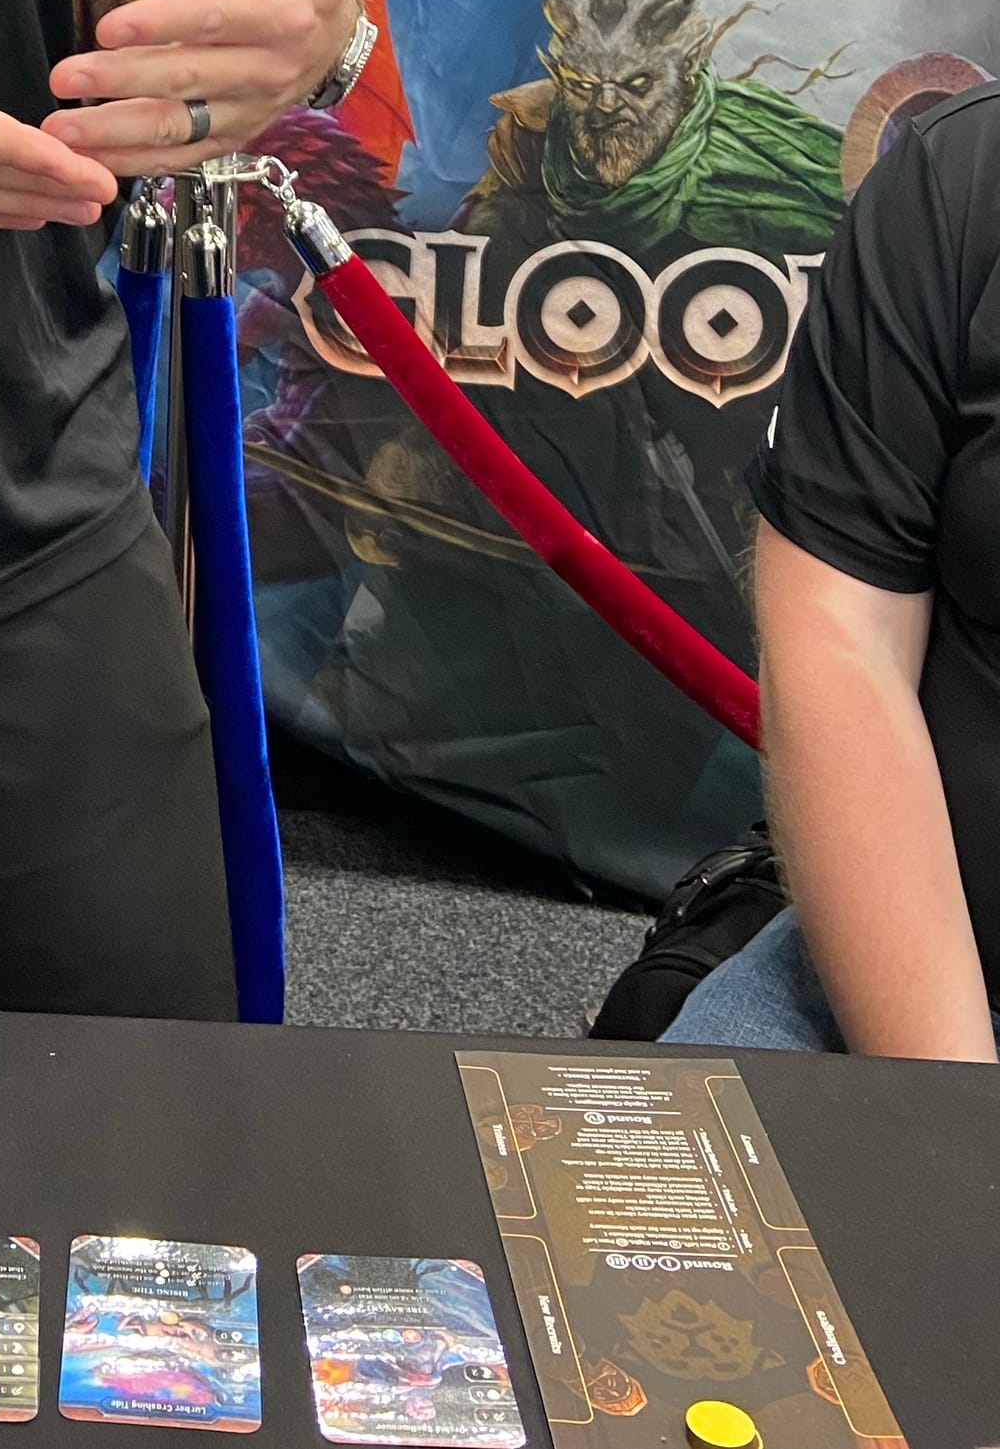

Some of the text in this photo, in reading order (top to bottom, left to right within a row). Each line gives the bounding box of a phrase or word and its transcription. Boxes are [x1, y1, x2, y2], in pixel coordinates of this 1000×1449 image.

[304, 234, 824, 395] GLOO
[606, 1114, 652, 1124] Round
[739, 1134, 759, 1165] Armory
[681, 1258, 734, 1271] Round
[537, 1294, 551, 1318] New
[543, 1318, 562, 1355] Recruits
[816, 1309, 847, 1366] Challengers
[131, 1399, 173, 1413] Crashing
